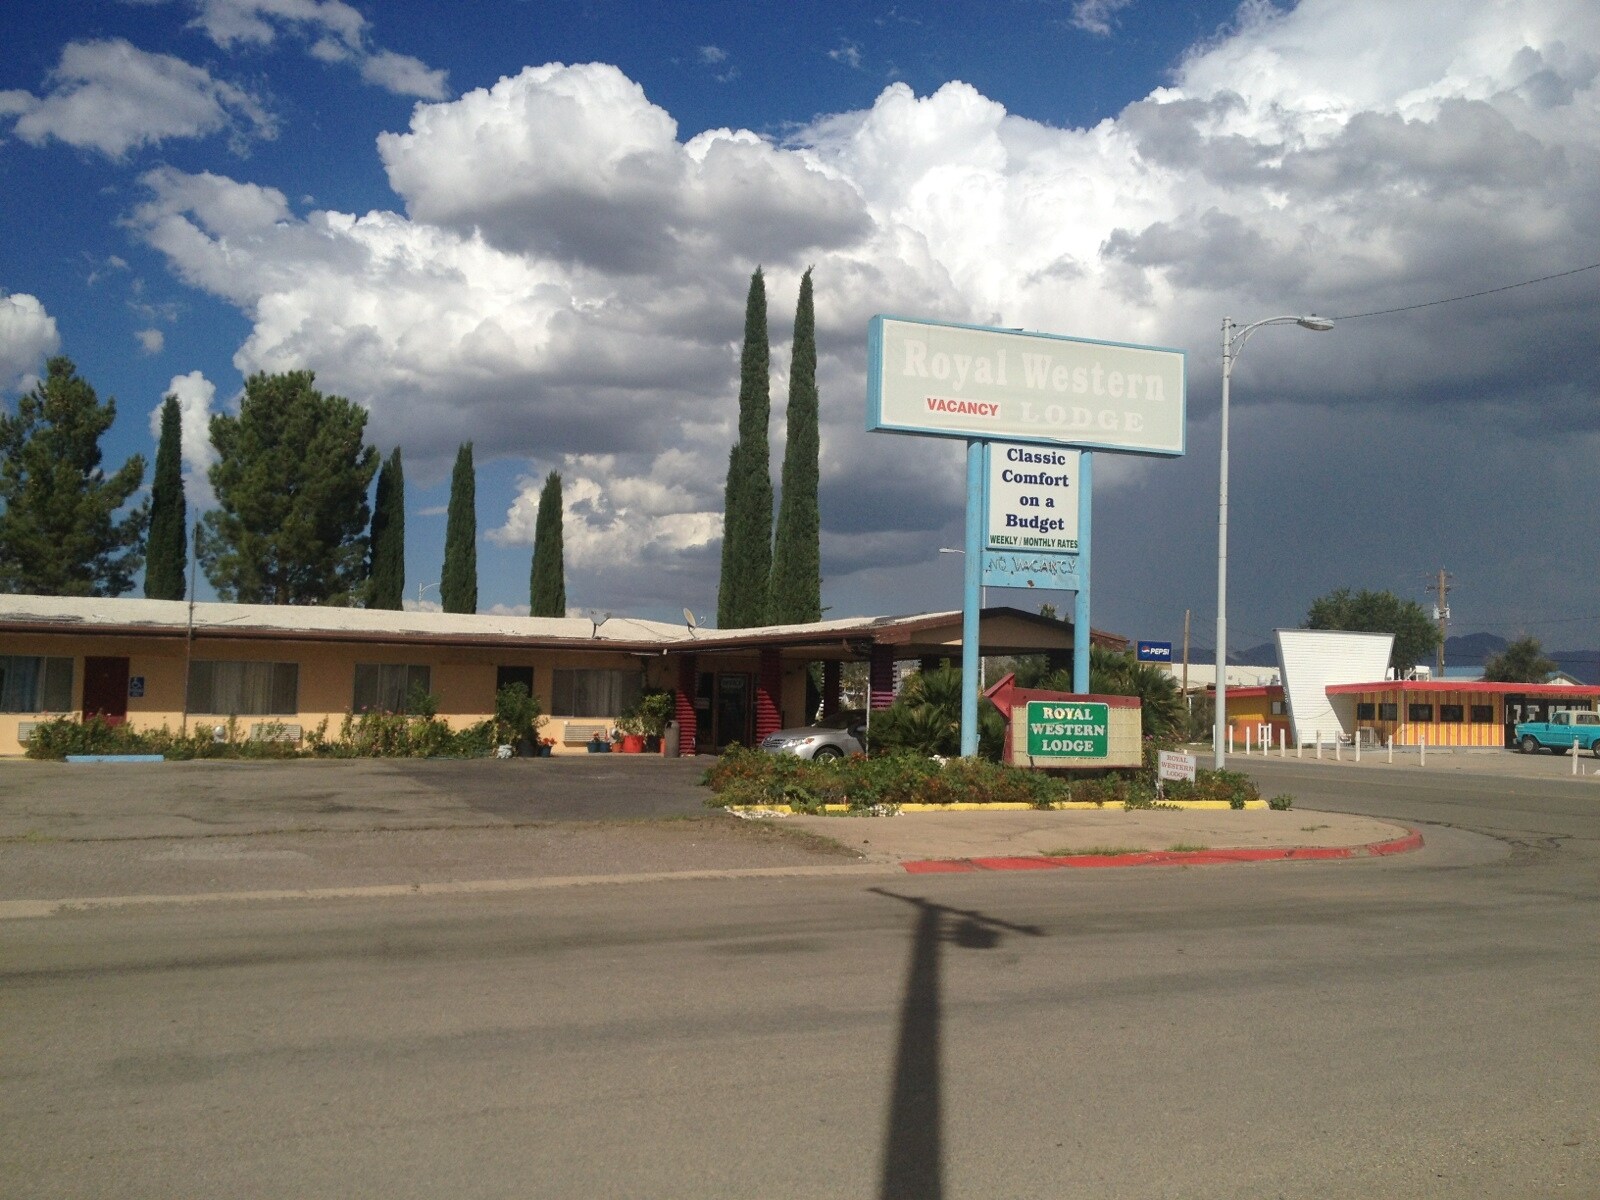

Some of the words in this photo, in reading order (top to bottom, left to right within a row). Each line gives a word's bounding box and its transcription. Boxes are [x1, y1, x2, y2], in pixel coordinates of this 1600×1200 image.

[902, 339, 1008, 391] Royal
[1022, 352, 1165, 401] Western
[927, 398, 999, 417] VACANCY
[1021, 402, 1144, 432] LODGE
[1007, 448, 1066, 465] Classic
[1002, 470, 1069, 487] Comfort
[1019, 495, 1039, 507] on
[1045, 498, 1055, 508] a
[1006, 514, 1065, 533] Budget
[990, 535, 1019, 545] WEEKLY
[1023, 537, 1055, 547] MONTHLY
[1057, 539, 1078, 549] RATES
[1042, 707, 1093, 721] ROYAL
[1031, 723, 1105, 736] WESTERN
[1042, 740, 1094, 752] LODGE
[1167, 755, 1189, 763] ROYAL
[1161, 762, 1194, 772] WESTERN
[1166, 770, 1188, 778] LODGE
